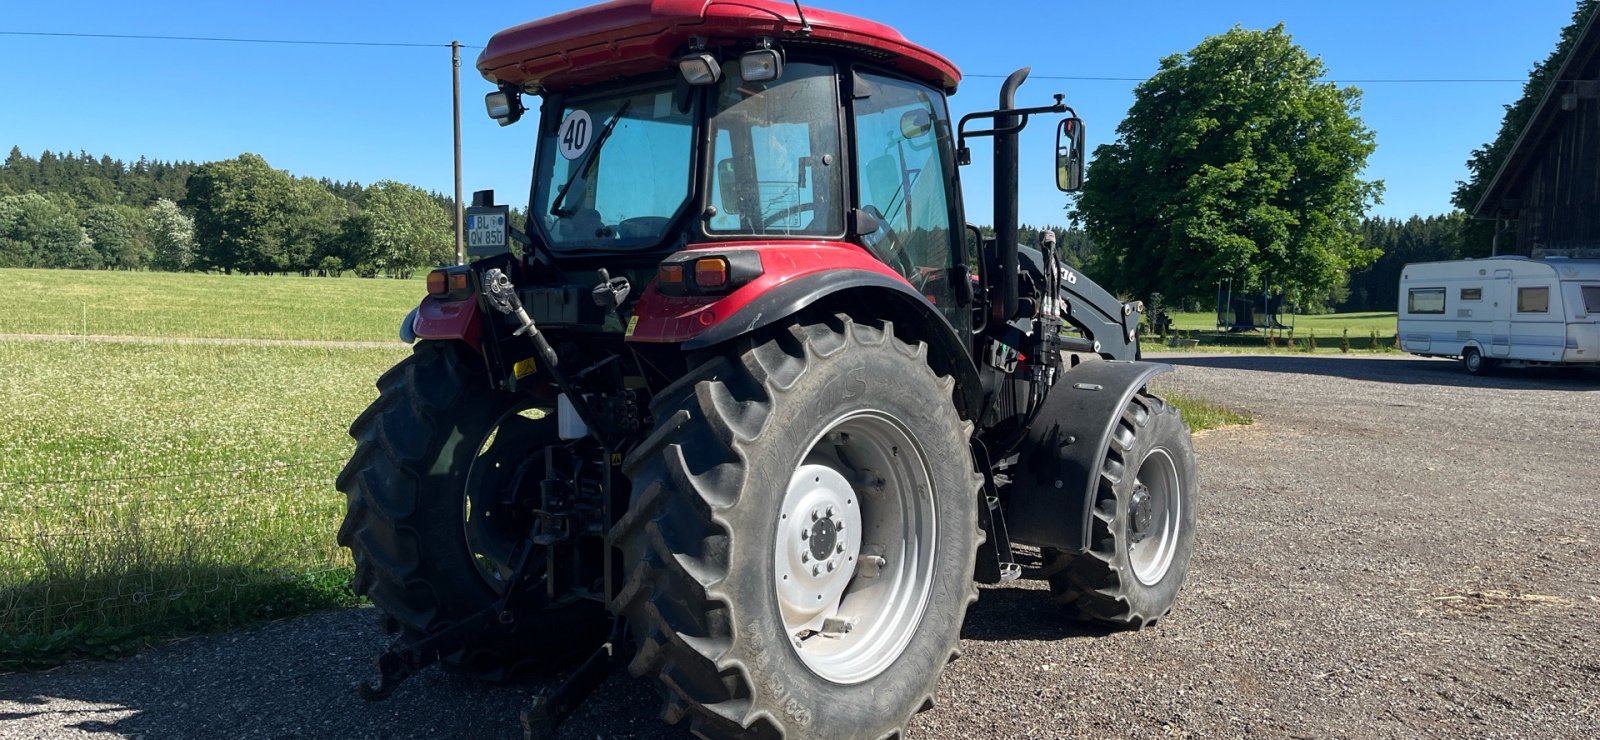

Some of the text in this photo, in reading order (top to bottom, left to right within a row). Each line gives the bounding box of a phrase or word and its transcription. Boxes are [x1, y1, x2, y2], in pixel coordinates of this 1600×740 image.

[563, 118, 586, 150] 40
[477, 215, 489, 230] BL
[471, 230, 502, 245] QW 850
